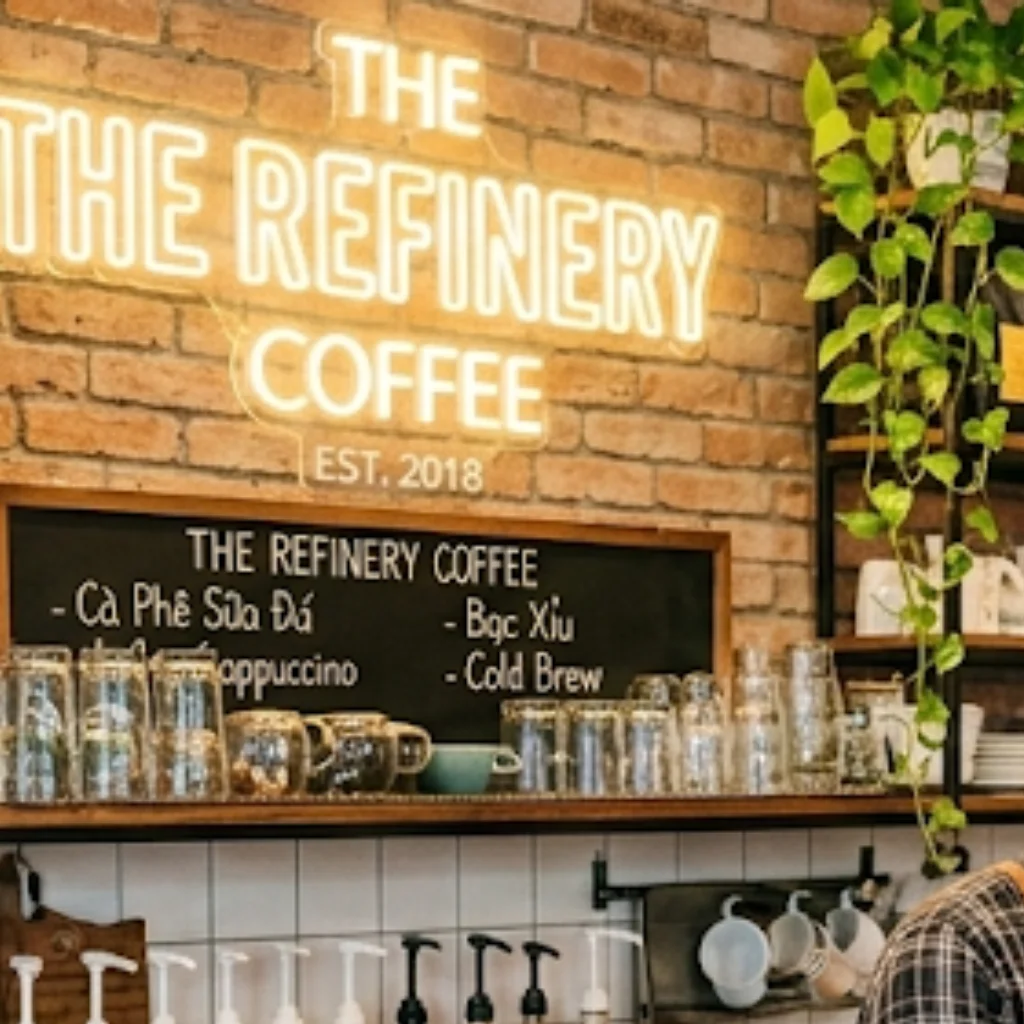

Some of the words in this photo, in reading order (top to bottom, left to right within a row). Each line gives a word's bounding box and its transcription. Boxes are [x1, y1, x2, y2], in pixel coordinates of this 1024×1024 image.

[331, 34, 483, 138] THE
[0, 99, 212, 279] THE
[232, 136, 720, 345] REFINERY
[246, 328, 545, 436] COFFEE
[315, 445, 390, 488] EST.
[397, 452, 484, 493] 2018
[184, 527, 256, 574] THE
[269, 531, 421, 582] REFINERY
[433, 541, 539, 588] COFFEE
[75, 579, 121, 628] Cà
[131, 581, 191, 628] Phê
[270, 589, 315, 634] Đá
[219, 653, 360, 701] appuccino
[464, 650, 525, 692] Cold
[535, 652, 605, 694] Brew
